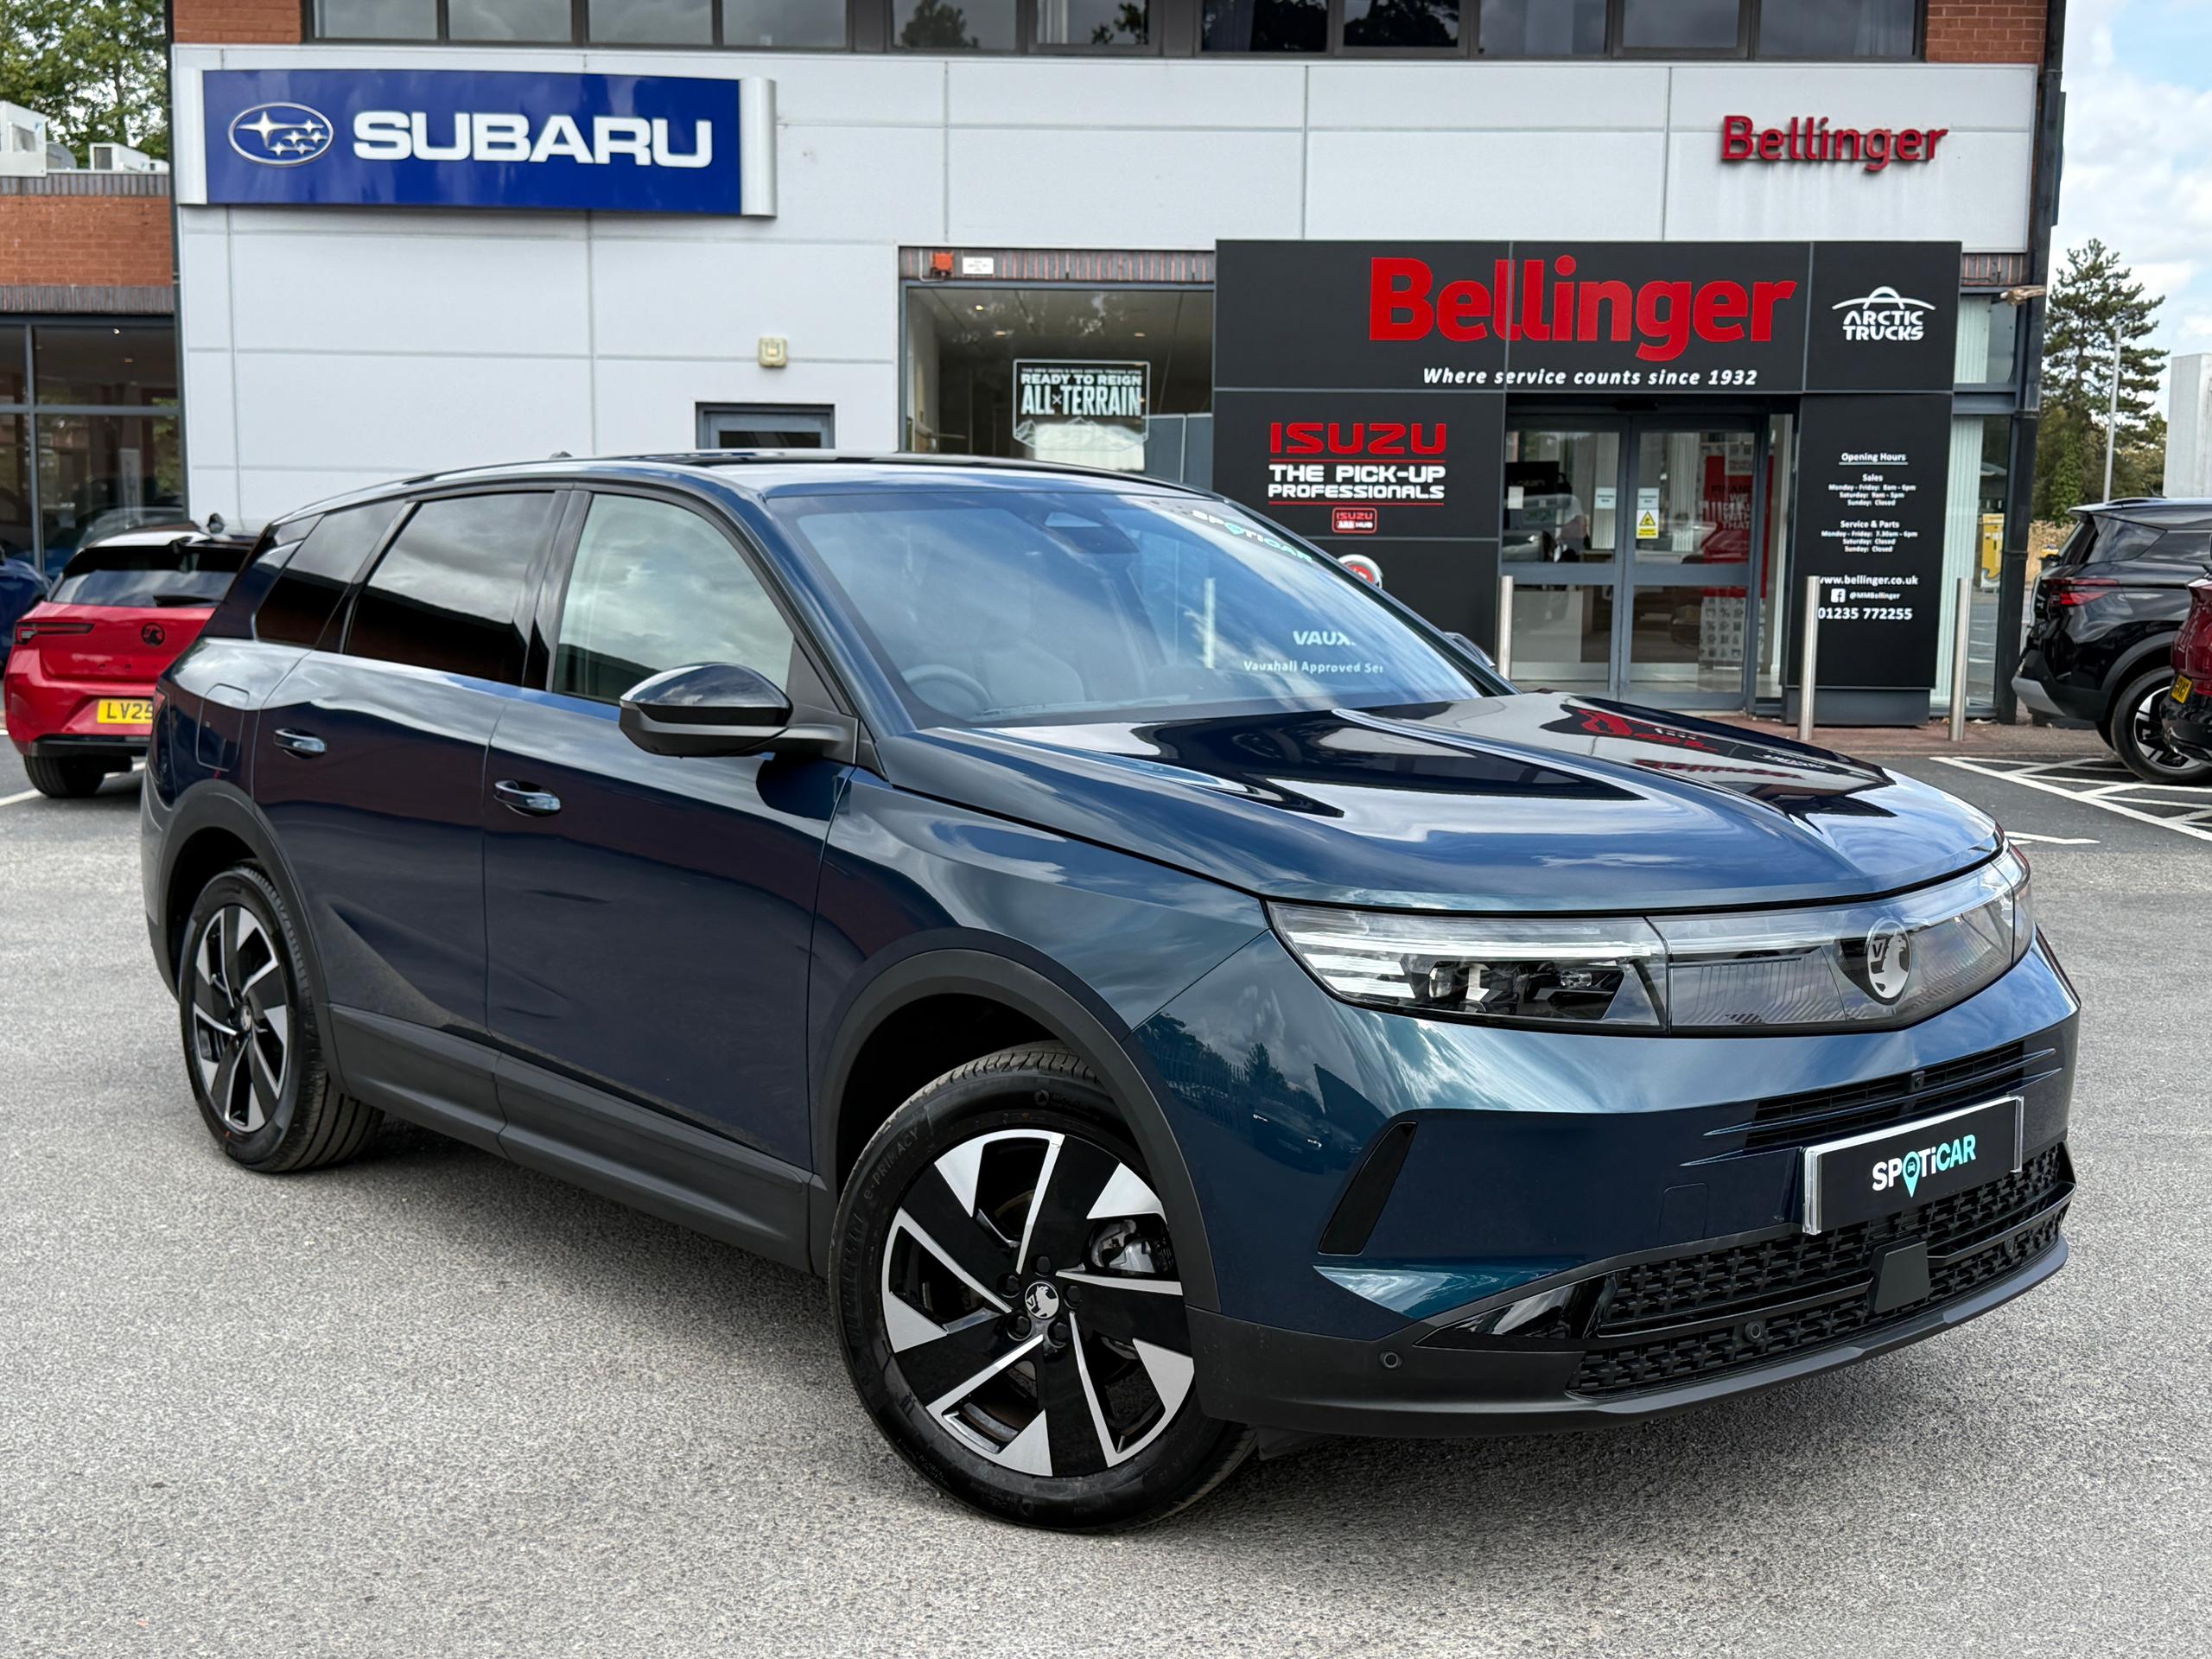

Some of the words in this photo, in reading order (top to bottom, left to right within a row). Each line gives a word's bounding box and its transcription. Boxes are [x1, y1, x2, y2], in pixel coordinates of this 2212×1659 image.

[353, 110, 713, 168] SUBARU
[1720, 115, 1949, 171] Bellinger
[1370, 254, 1798, 361] Bellinger
[1843, 310, 1924, 326] ARCTIC
[1842, 325, 1924, 341] TRUCKS
[1020, 373, 1071, 385] READY
[1073, 373, 1095, 385] TO
[1096, 374, 1143, 386] REIGN
[1423, 367, 1487, 384] Where
[1494, 368, 1567, 385] service
[1573, 369, 1642, 385] counts
[1648, 369, 1700, 386] since
[1707, 369, 1758, 386] 1932
[1060, 385, 1142, 416] TERRAIN
[1269, 422, 1447, 455] ISUZU
[1840, 452, 1878, 462] Opening
[1879, 452, 1907, 461] Hours
[1268, 464, 1325, 482] THE
[1335, 464, 1446, 484] PICK-UP
[1862, 473, 1884, 482] Sales
[1268, 484, 1446, 499] PROFESSIONALS
[1337, 511, 1373, 520] ISUZU
[1840, 519, 1869, 528] Service
[1870, 519, 1878, 528] &
[1878, 519, 1900, 528] Parts
[1817, 607, 1859, 620] 01235
[1863, 607, 1913, 620] 772255
[1293, 630, 1357, 646] VAUX
[1243, 660, 1298, 672] Vauxhall
[1301, 660, 1361, 675] Approved
